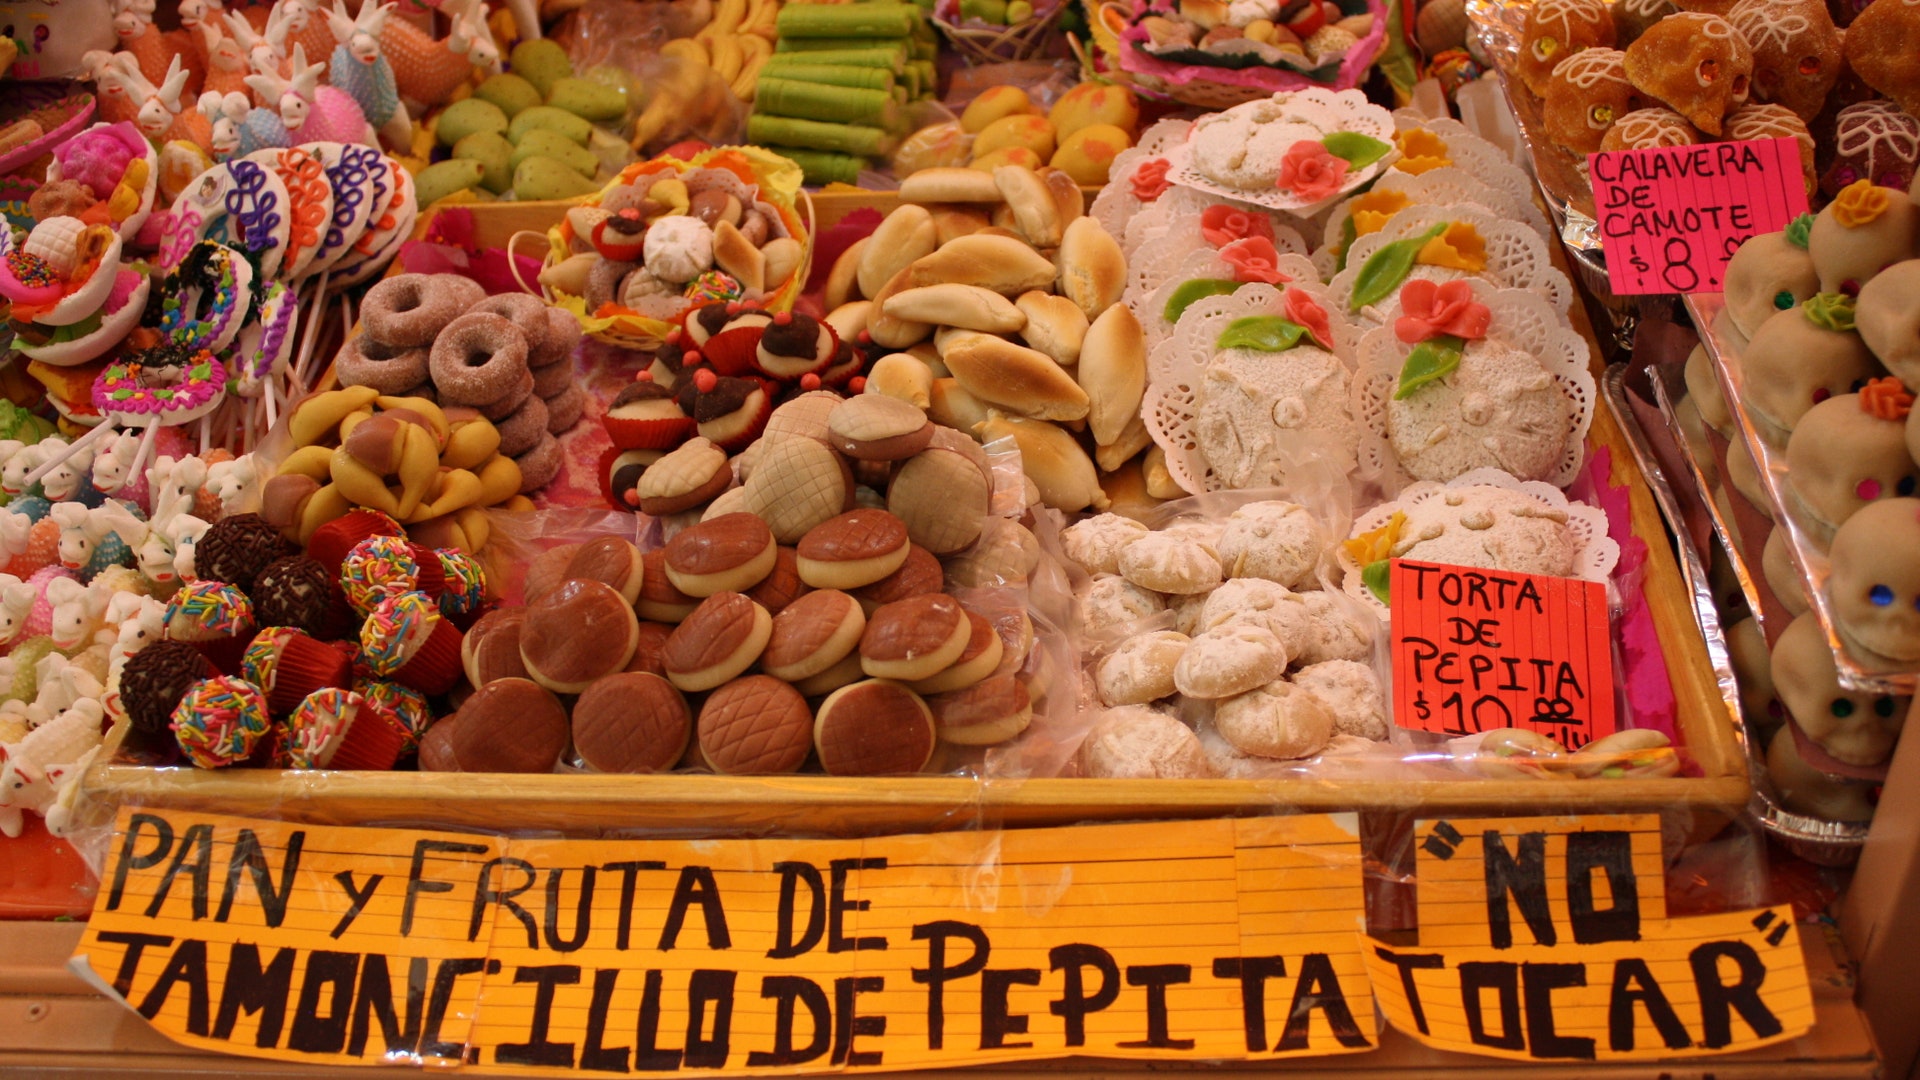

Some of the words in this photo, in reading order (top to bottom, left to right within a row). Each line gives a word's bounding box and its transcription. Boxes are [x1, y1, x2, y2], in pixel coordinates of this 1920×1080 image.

[1594, 144, 1763, 182] CALAVERA
[1604, 185, 1655, 209] DE
[1604, 205, 1752, 238] CAMOTE
[1398, 563, 1543, 614] TORTA
[1447, 616, 1502, 648] DE
[1401, 636, 1585, 700] PEPITA
[106, 812, 306, 928] PAN
[399, 837, 732, 953] FRUTA
[765, 857, 888, 959] DE
[747, 974, 886, 1068] DE
[911, 919, 1373, 1053] PEPITA
